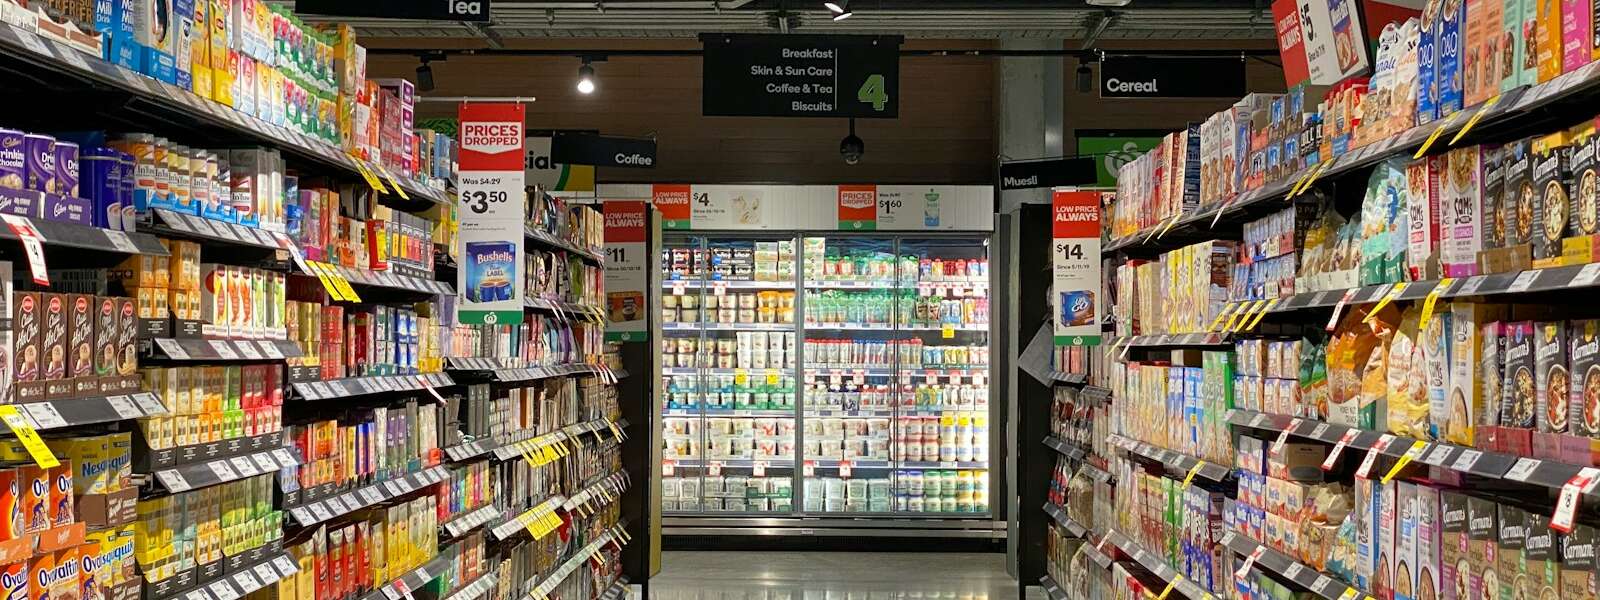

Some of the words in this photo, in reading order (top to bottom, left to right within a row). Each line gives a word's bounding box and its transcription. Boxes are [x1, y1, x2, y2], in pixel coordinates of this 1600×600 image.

[782, 48, 833, 58] Breakfast
[751, 65, 773, 76] Skin
[775, 66, 783, 76] &
[785, 66, 805, 76] Sun
[807, 66, 833, 77] Care
[766, 83, 800, 94] Coffee
[802, 84, 811, 93] &
[812, 83, 833, 94] Tea
[1107, 78, 1158, 92] Cereal
[857, 74, 888, 111] 4
[792, 101, 833, 112] Biscuits
[465, 125, 519, 136] PRICES
[464, 137, 519, 146] DROPPED
[525, 150, 557, 169] ia
[615, 152, 652, 166] Coffee
[480, 177, 501, 186] $4.29
[1004, 175, 1038, 187] Muesli
[655, 197, 689, 205] ALWAYS
[693, 192, 710, 207] $4
[842, 192, 872, 200] PRICES
[605, 218, 644, 227] ALWAYS
[1056, 212, 1098, 222] ALWAYS
[606, 247, 625, 262] $11
[1056, 243, 1083, 260] $14
[477, 250, 513, 265] Bushells
[486, 269, 504, 277] LABEL
